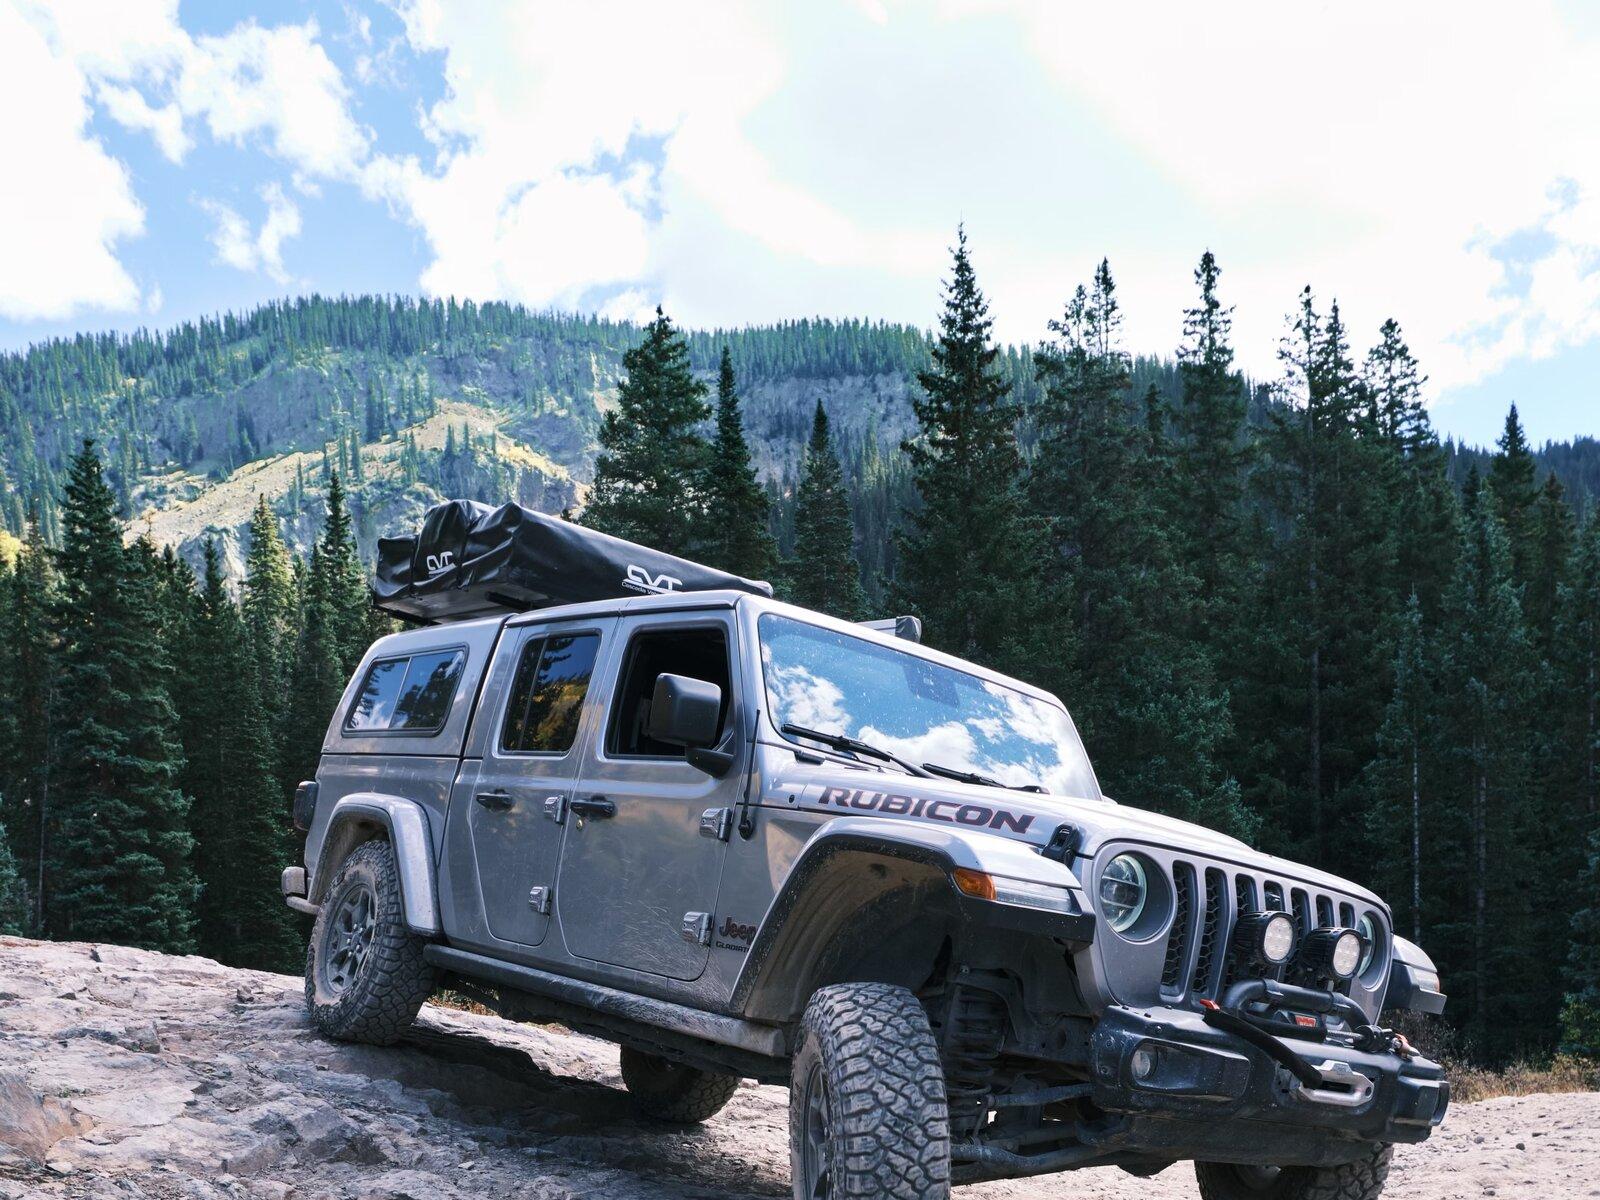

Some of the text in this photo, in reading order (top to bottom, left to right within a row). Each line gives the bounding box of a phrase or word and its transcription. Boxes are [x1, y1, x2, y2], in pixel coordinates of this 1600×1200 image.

[818, 786, 1036, 834] RUBICON
[719, 916, 757, 946] Jeep
[716, 941, 750, 953] GLADIAT
